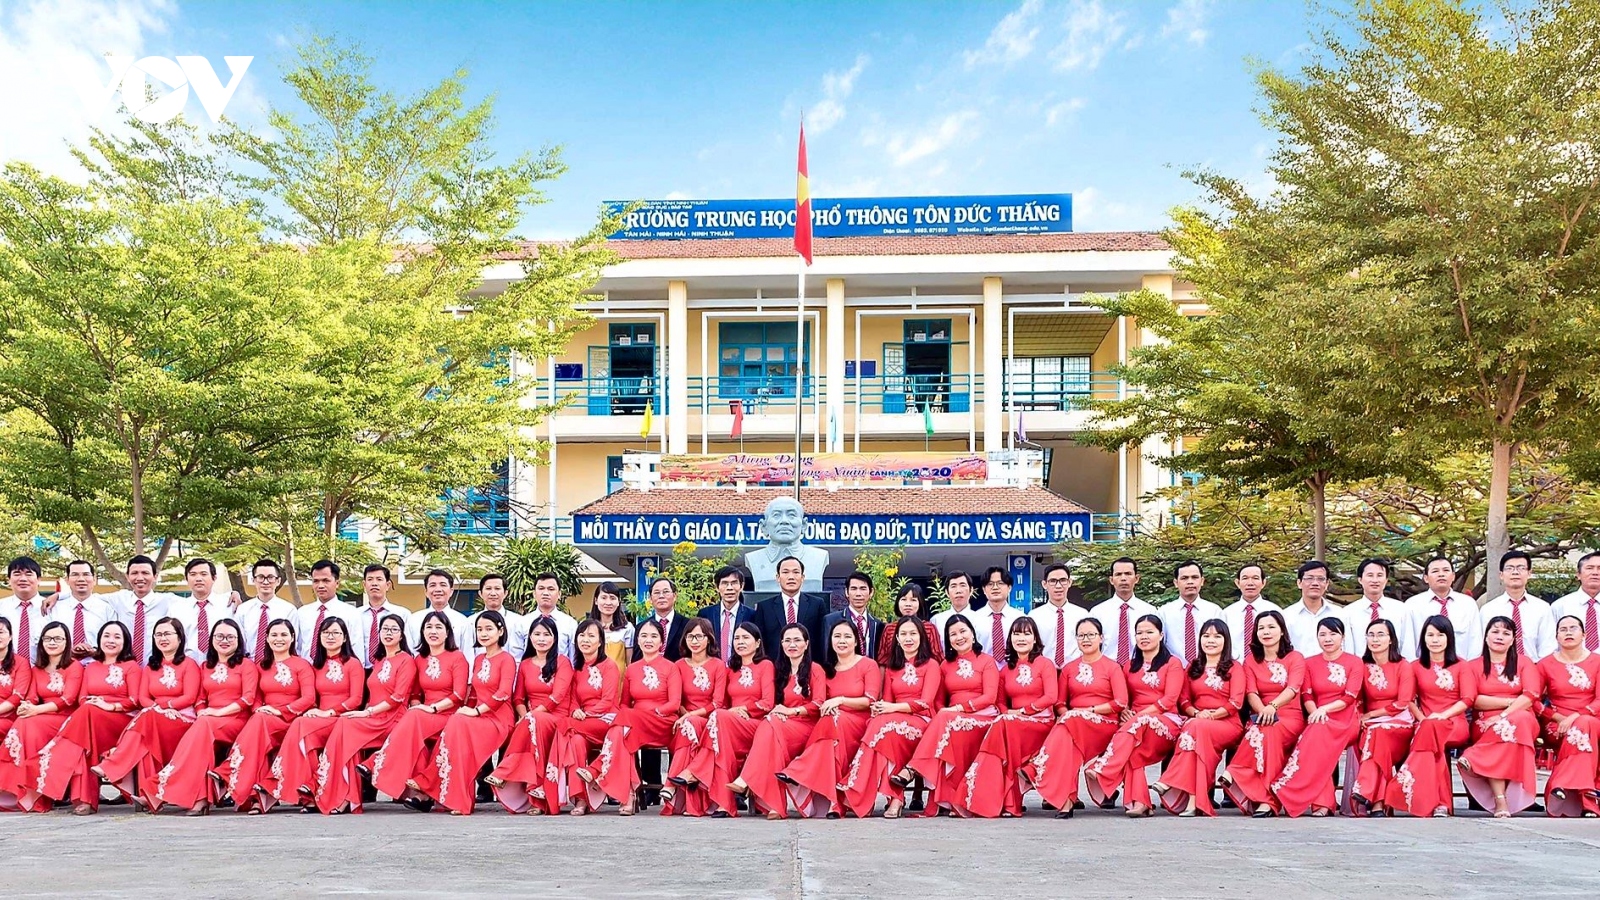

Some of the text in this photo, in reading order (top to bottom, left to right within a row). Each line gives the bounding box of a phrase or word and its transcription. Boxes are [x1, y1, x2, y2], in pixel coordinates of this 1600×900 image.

[694, 211, 755, 227] TRUNG
[846, 205, 908, 226] THÔNG
[913, 204, 950, 225] TÔN
[954, 203, 992, 224] ĐỨC
[997, 200, 1060, 222] THẮNG
[581, 515, 609, 540] MỖI
[613, 516, 655, 540] THẦY
[663, 518, 681, 540] CÔ
[684, 518, 721, 540] GIÁO
[725, 517, 745, 541] LÀ
[840, 522, 871, 544] ĐẠO
[875, 517, 910, 541] ĐỨC,
[912, 517, 935, 544] TỰ
[937, 521, 971, 544] HỌC
[975, 517, 997, 540] VÀ
[1001, 517, 1046, 540] SÁNG
[1050, 521, 1083, 543] TẠO
